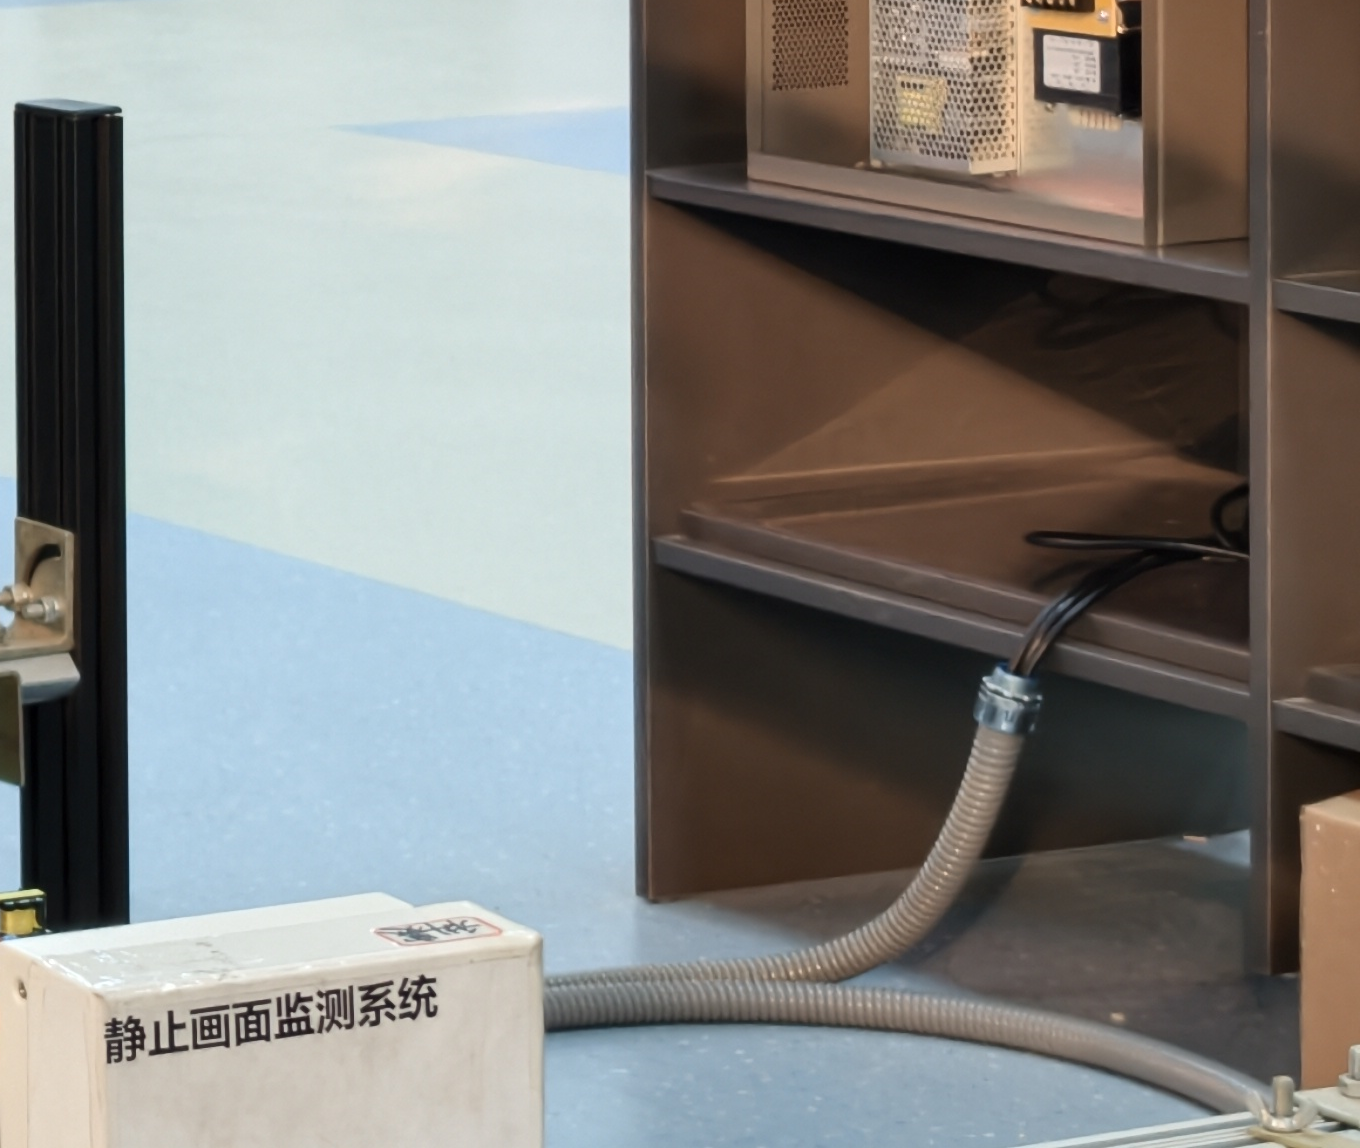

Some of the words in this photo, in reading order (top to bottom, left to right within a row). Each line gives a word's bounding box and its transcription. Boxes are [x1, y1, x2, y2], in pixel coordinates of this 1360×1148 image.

[104, 974, 438, 1064] 静止画面监测系统
